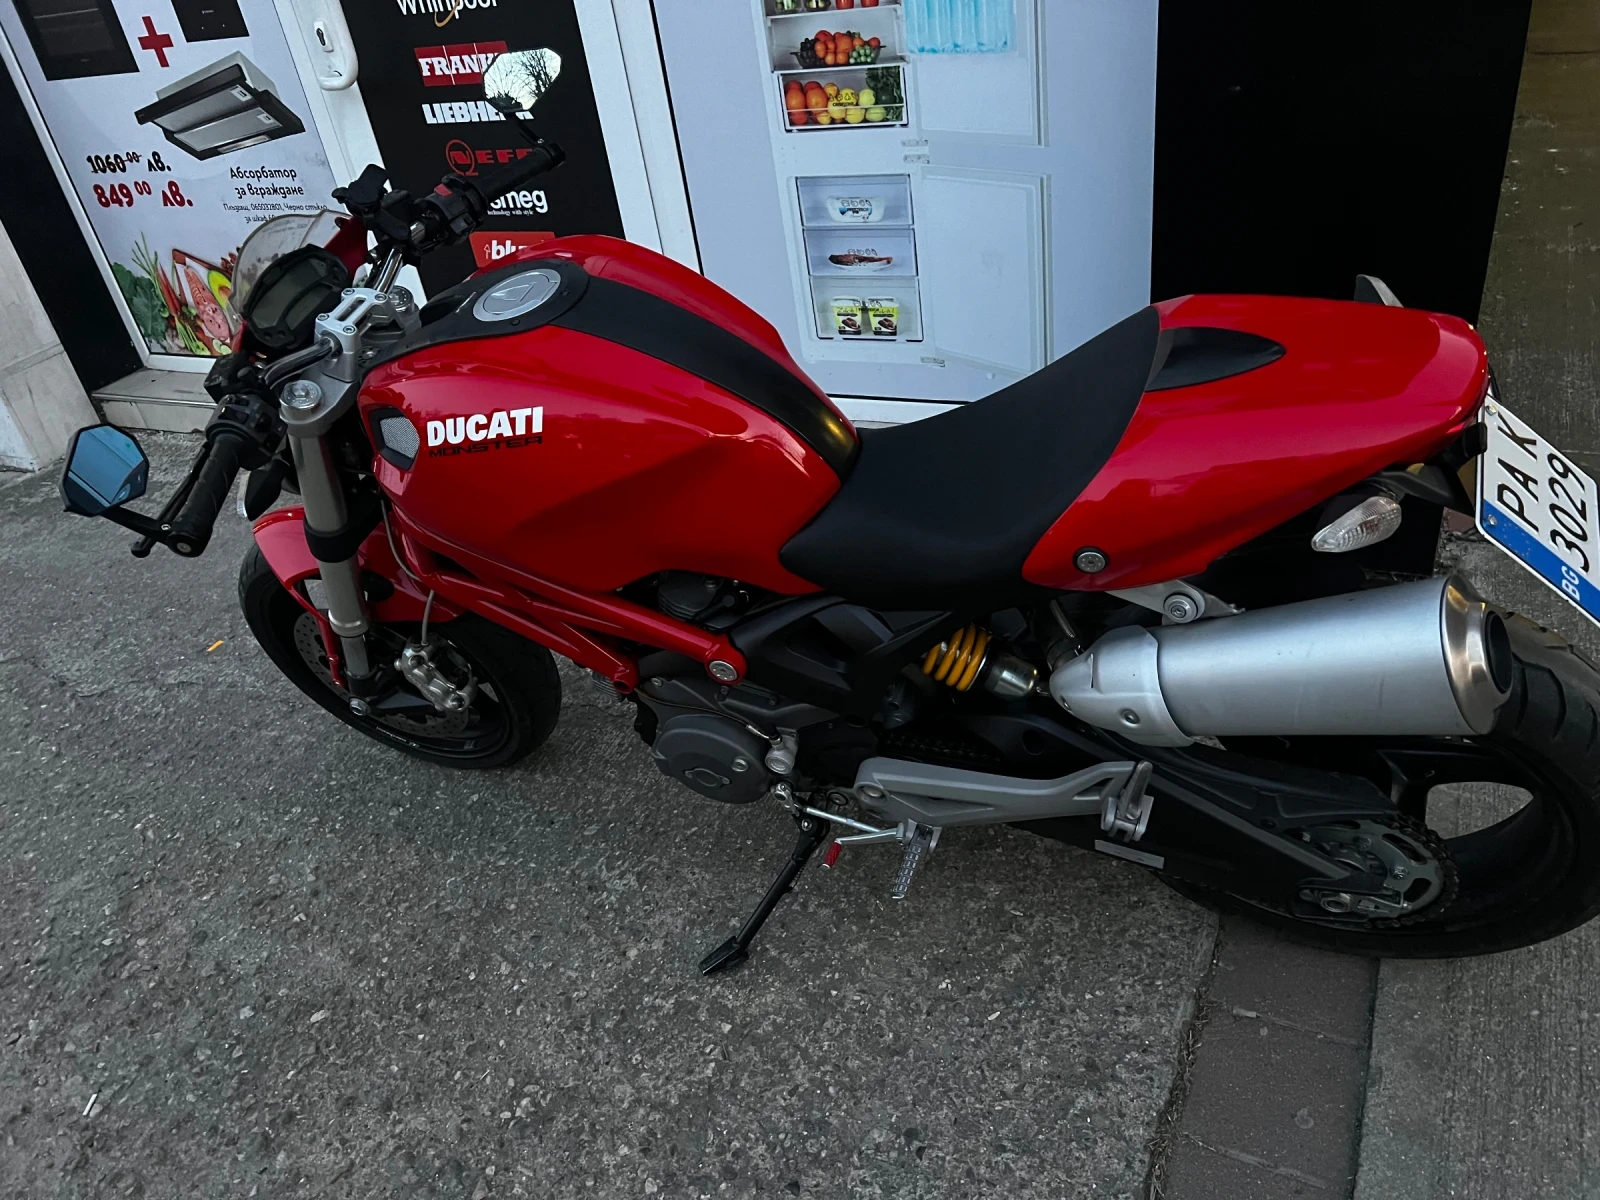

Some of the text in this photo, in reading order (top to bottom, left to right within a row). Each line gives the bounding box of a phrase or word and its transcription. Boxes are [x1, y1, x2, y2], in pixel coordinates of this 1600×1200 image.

[418, 53, 499, 77] FRANK
[421, 101, 534, 125] LIEBHE
[147, 151, 172, 172] лв.
[230, 165, 297, 182] Абсорбатор
[162, 180, 194, 207] лв.
[235, 183, 305, 199] за вграждане
[490, 190, 549, 213] smeg
[283, 203, 305, 213] Черно
[426, 406, 544, 447] DUCATI
[428, 435, 543, 458] MONSTER
[1547, 452, 1591, 574] 3029
[1561, 565, 1581, 601] BG
